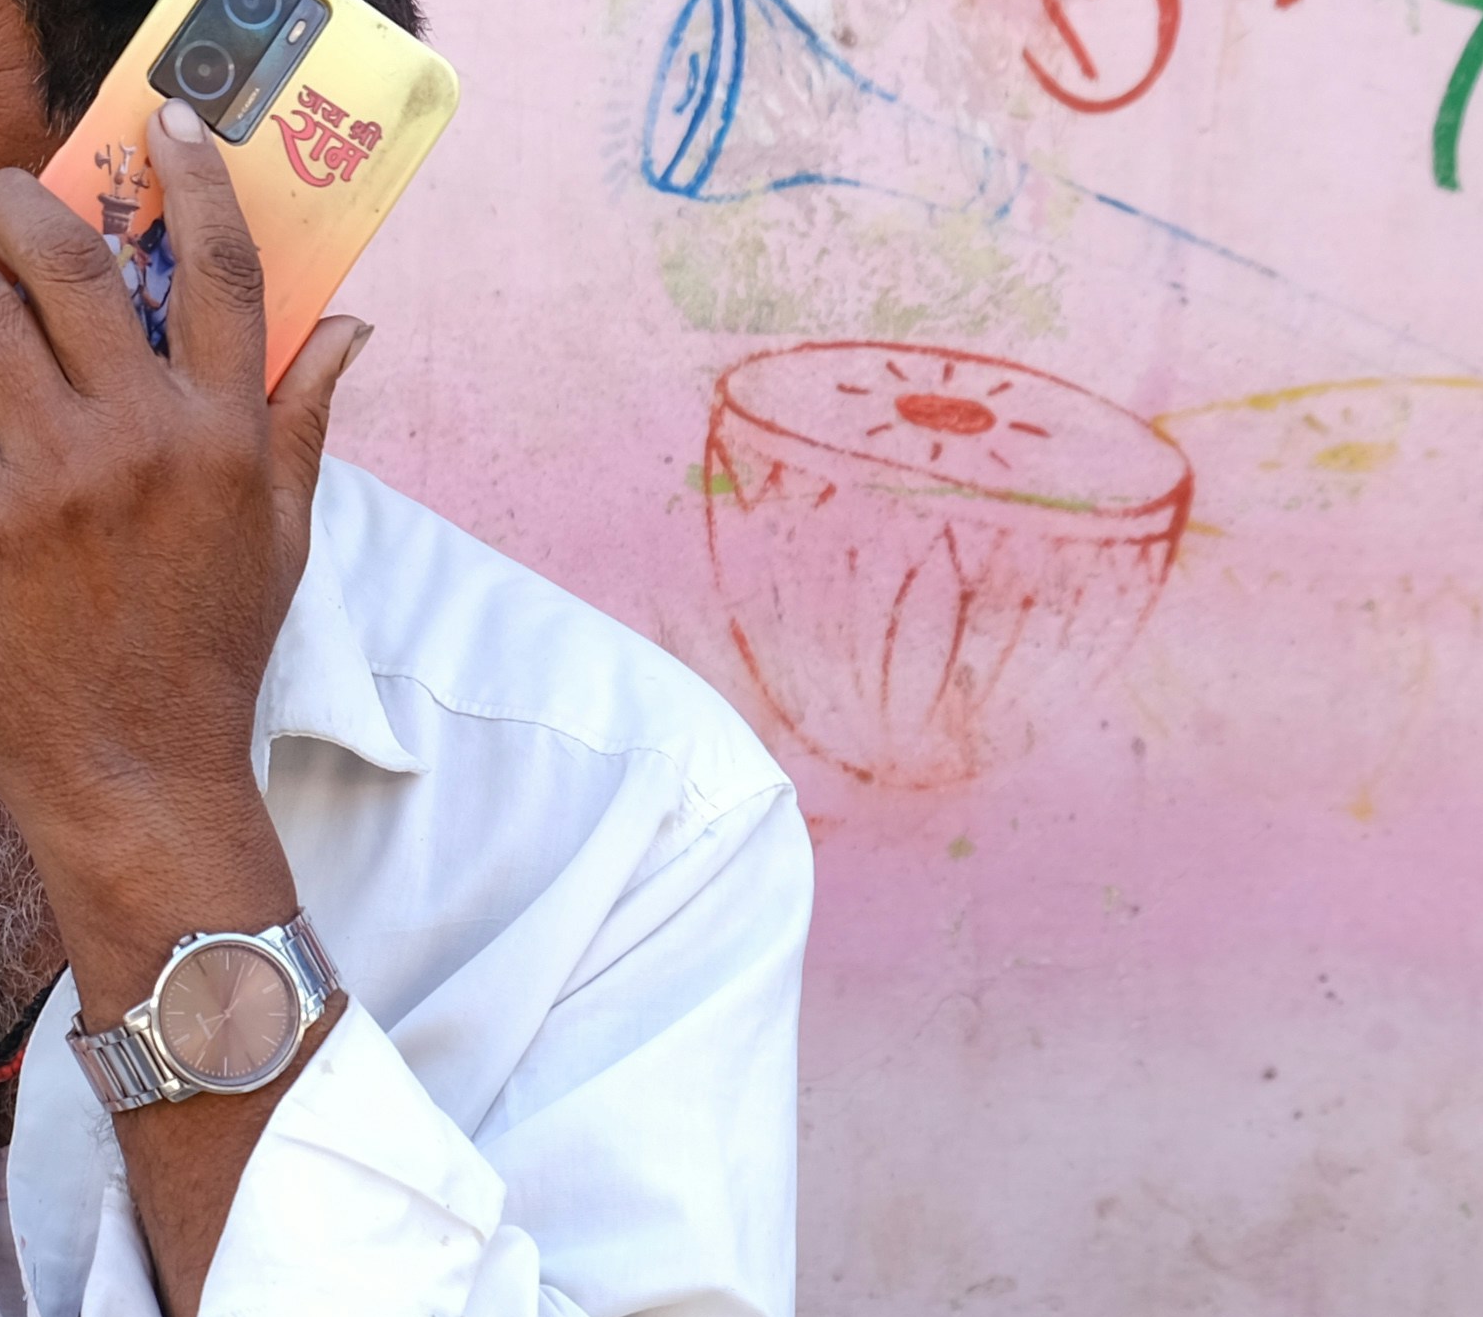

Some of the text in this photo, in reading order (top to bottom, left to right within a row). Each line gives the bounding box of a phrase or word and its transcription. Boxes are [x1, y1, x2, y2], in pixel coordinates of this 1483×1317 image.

[269, 108, 370, 188] राम
[296, 83, 384, 153] जय श्री
